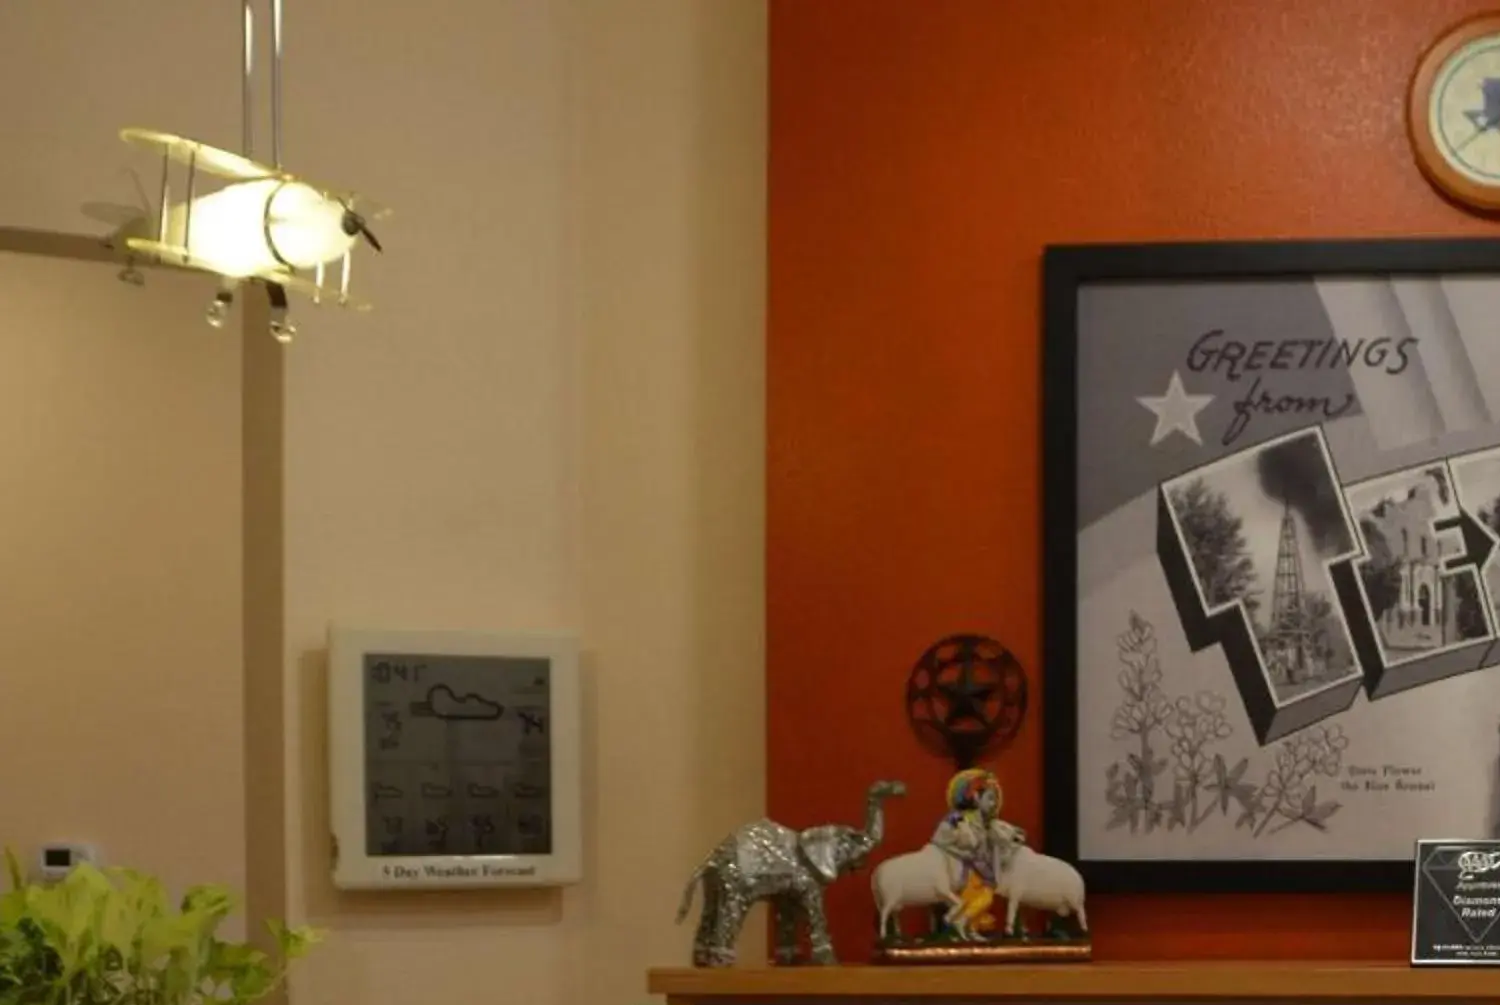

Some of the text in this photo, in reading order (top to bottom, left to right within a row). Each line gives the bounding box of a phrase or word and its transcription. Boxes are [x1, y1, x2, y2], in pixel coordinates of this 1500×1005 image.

[1186, 329, 1420, 381] GREETINGS
[1221, 377, 1357, 445] from
[394, 866, 419, 879] Day
[424, 866, 477, 877] Weather
[482, 865, 534, 877] Forecast
[1461, 907, 1496, 918] Rated
